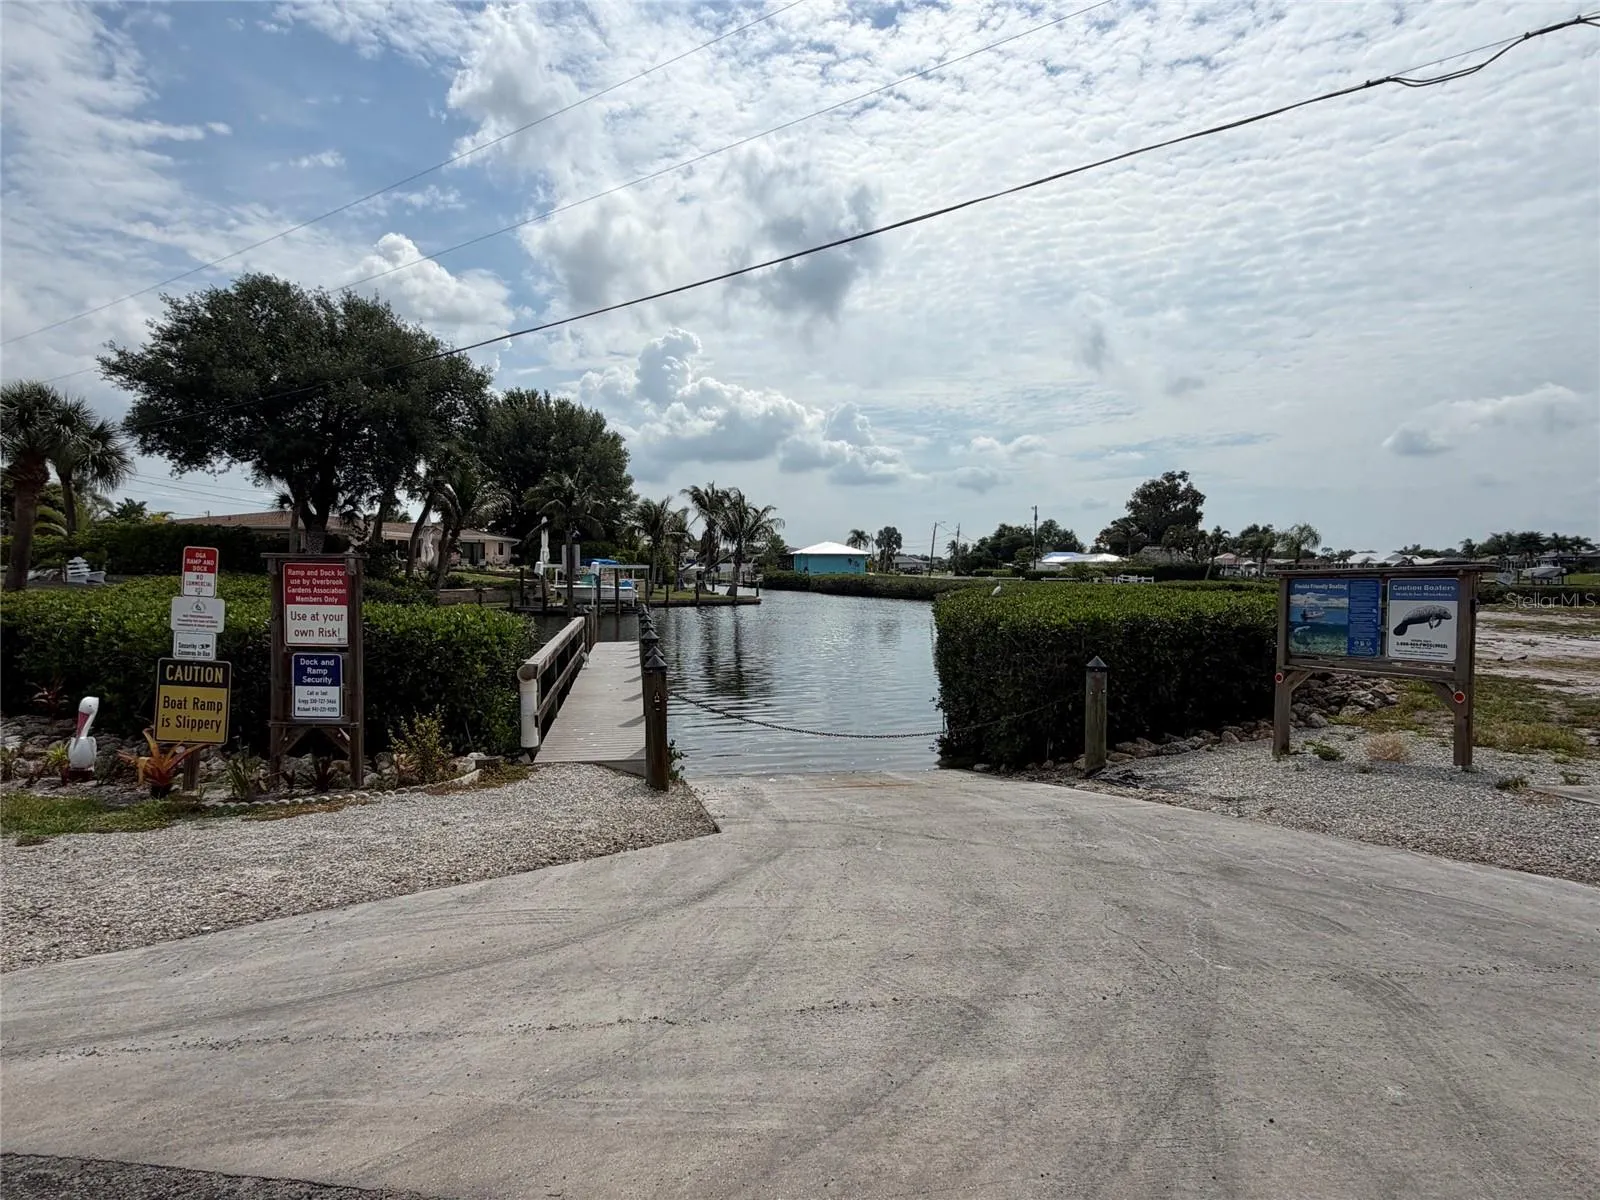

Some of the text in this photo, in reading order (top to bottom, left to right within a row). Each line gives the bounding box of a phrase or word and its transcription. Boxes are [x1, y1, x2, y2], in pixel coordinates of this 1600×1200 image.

[287, 568, 306, 577] Ramp
[320, 569, 336, 577] Dock
[336, 568, 346, 577] for
[302, 578, 311, 586] by
[312, 578, 344, 586] Overbrook
[287, 585, 312, 594] Gardens
[295, 595, 338, 605] Members Only
[290, 610, 344, 625] Use at your
[294, 627, 341, 638] own Risk!
[299, 657, 319, 666] Dock
[166, 665, 223, 683] CAUTION
[306, 666, 328, 676] Ramp
[302, 675, 333, 685] Security
[163, 695, 223, 715] Boat Ramp
[162, 714, 222, 734] is Slippery
